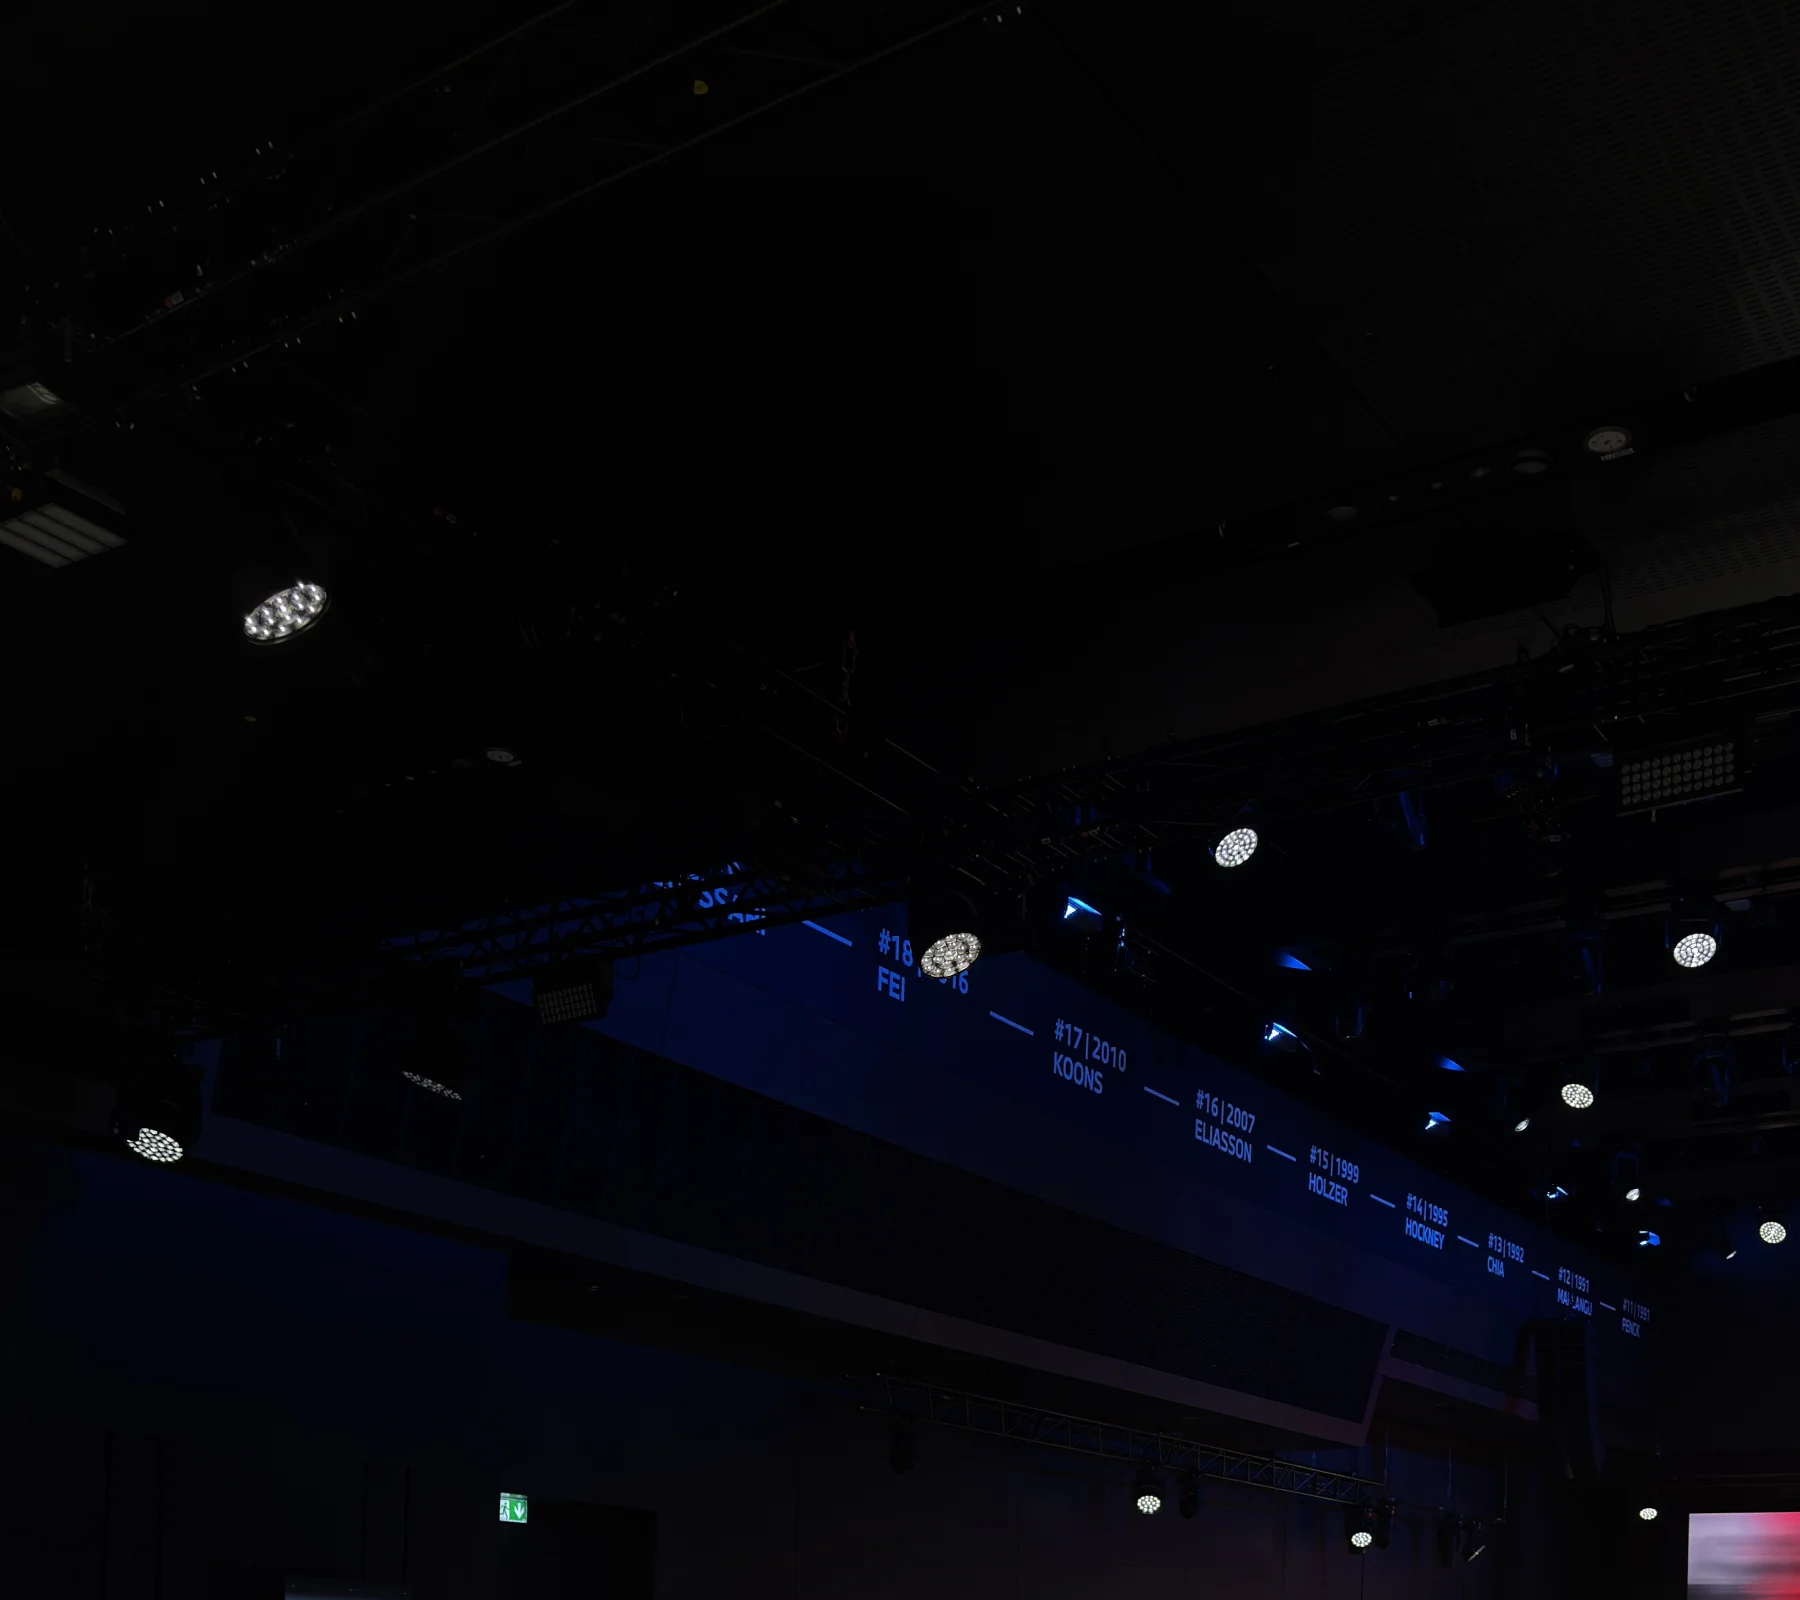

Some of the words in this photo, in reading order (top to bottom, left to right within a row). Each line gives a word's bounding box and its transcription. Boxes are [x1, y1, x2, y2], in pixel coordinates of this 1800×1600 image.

[878, 965, 906, 1002] FEI
[1052, 1052, 1104, 1095] KOONS
[1195, 1119, 1252, 1163] ELIASSON
[1308, 1172, 1348, 1206] HOLZER
[1405, 1217, 1445, 1250] HOCKNEY
[1486, 1256, 1505, 1278] CHIA
